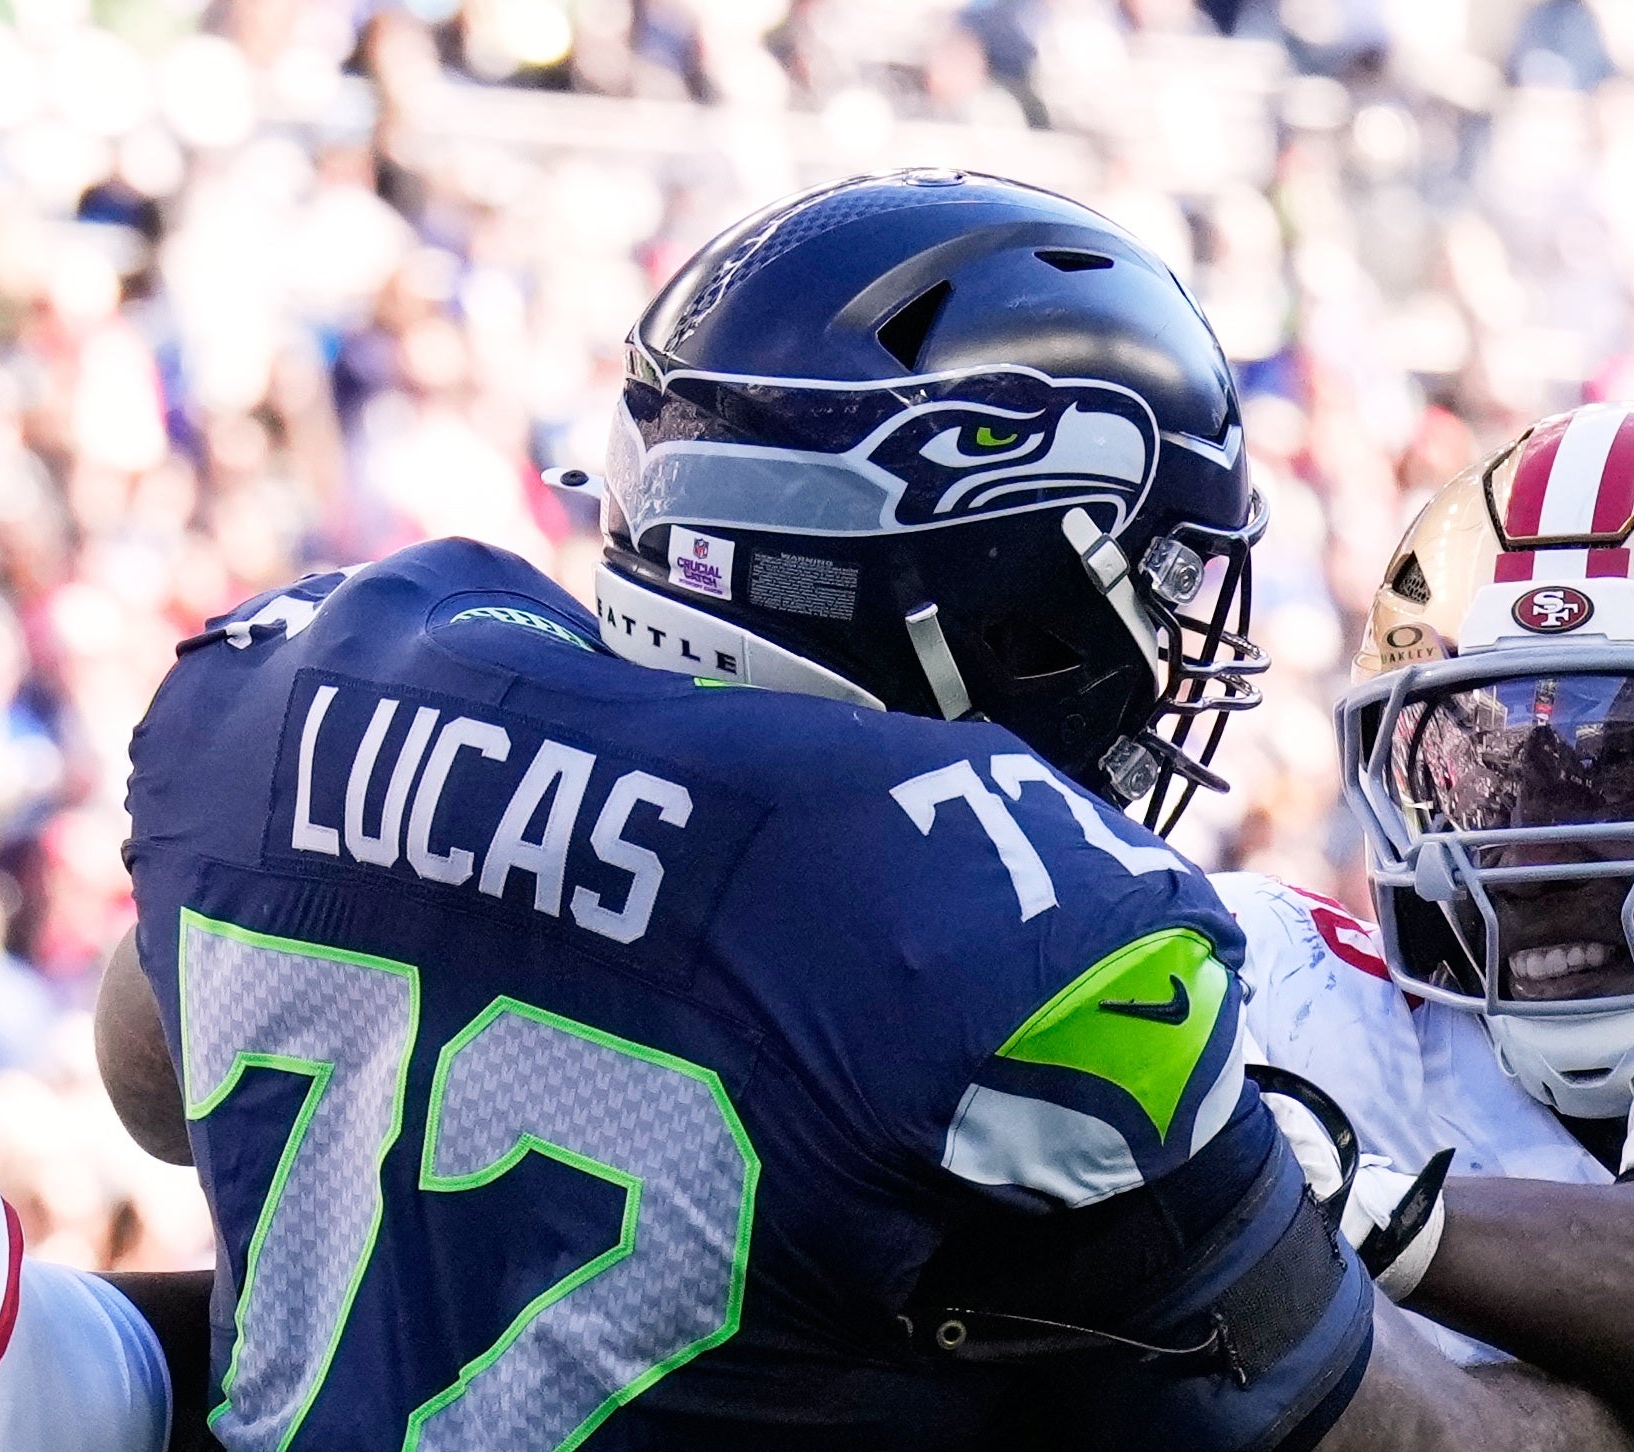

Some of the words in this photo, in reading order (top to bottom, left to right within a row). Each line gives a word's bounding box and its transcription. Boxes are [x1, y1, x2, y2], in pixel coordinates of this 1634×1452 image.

[677, 557, 722, 579] CRUCIAL
[597, 598, 737, 675] EATTLE
[291, 684, 696, 945] LUCAS
[888, 753, 1192, 923] 72
